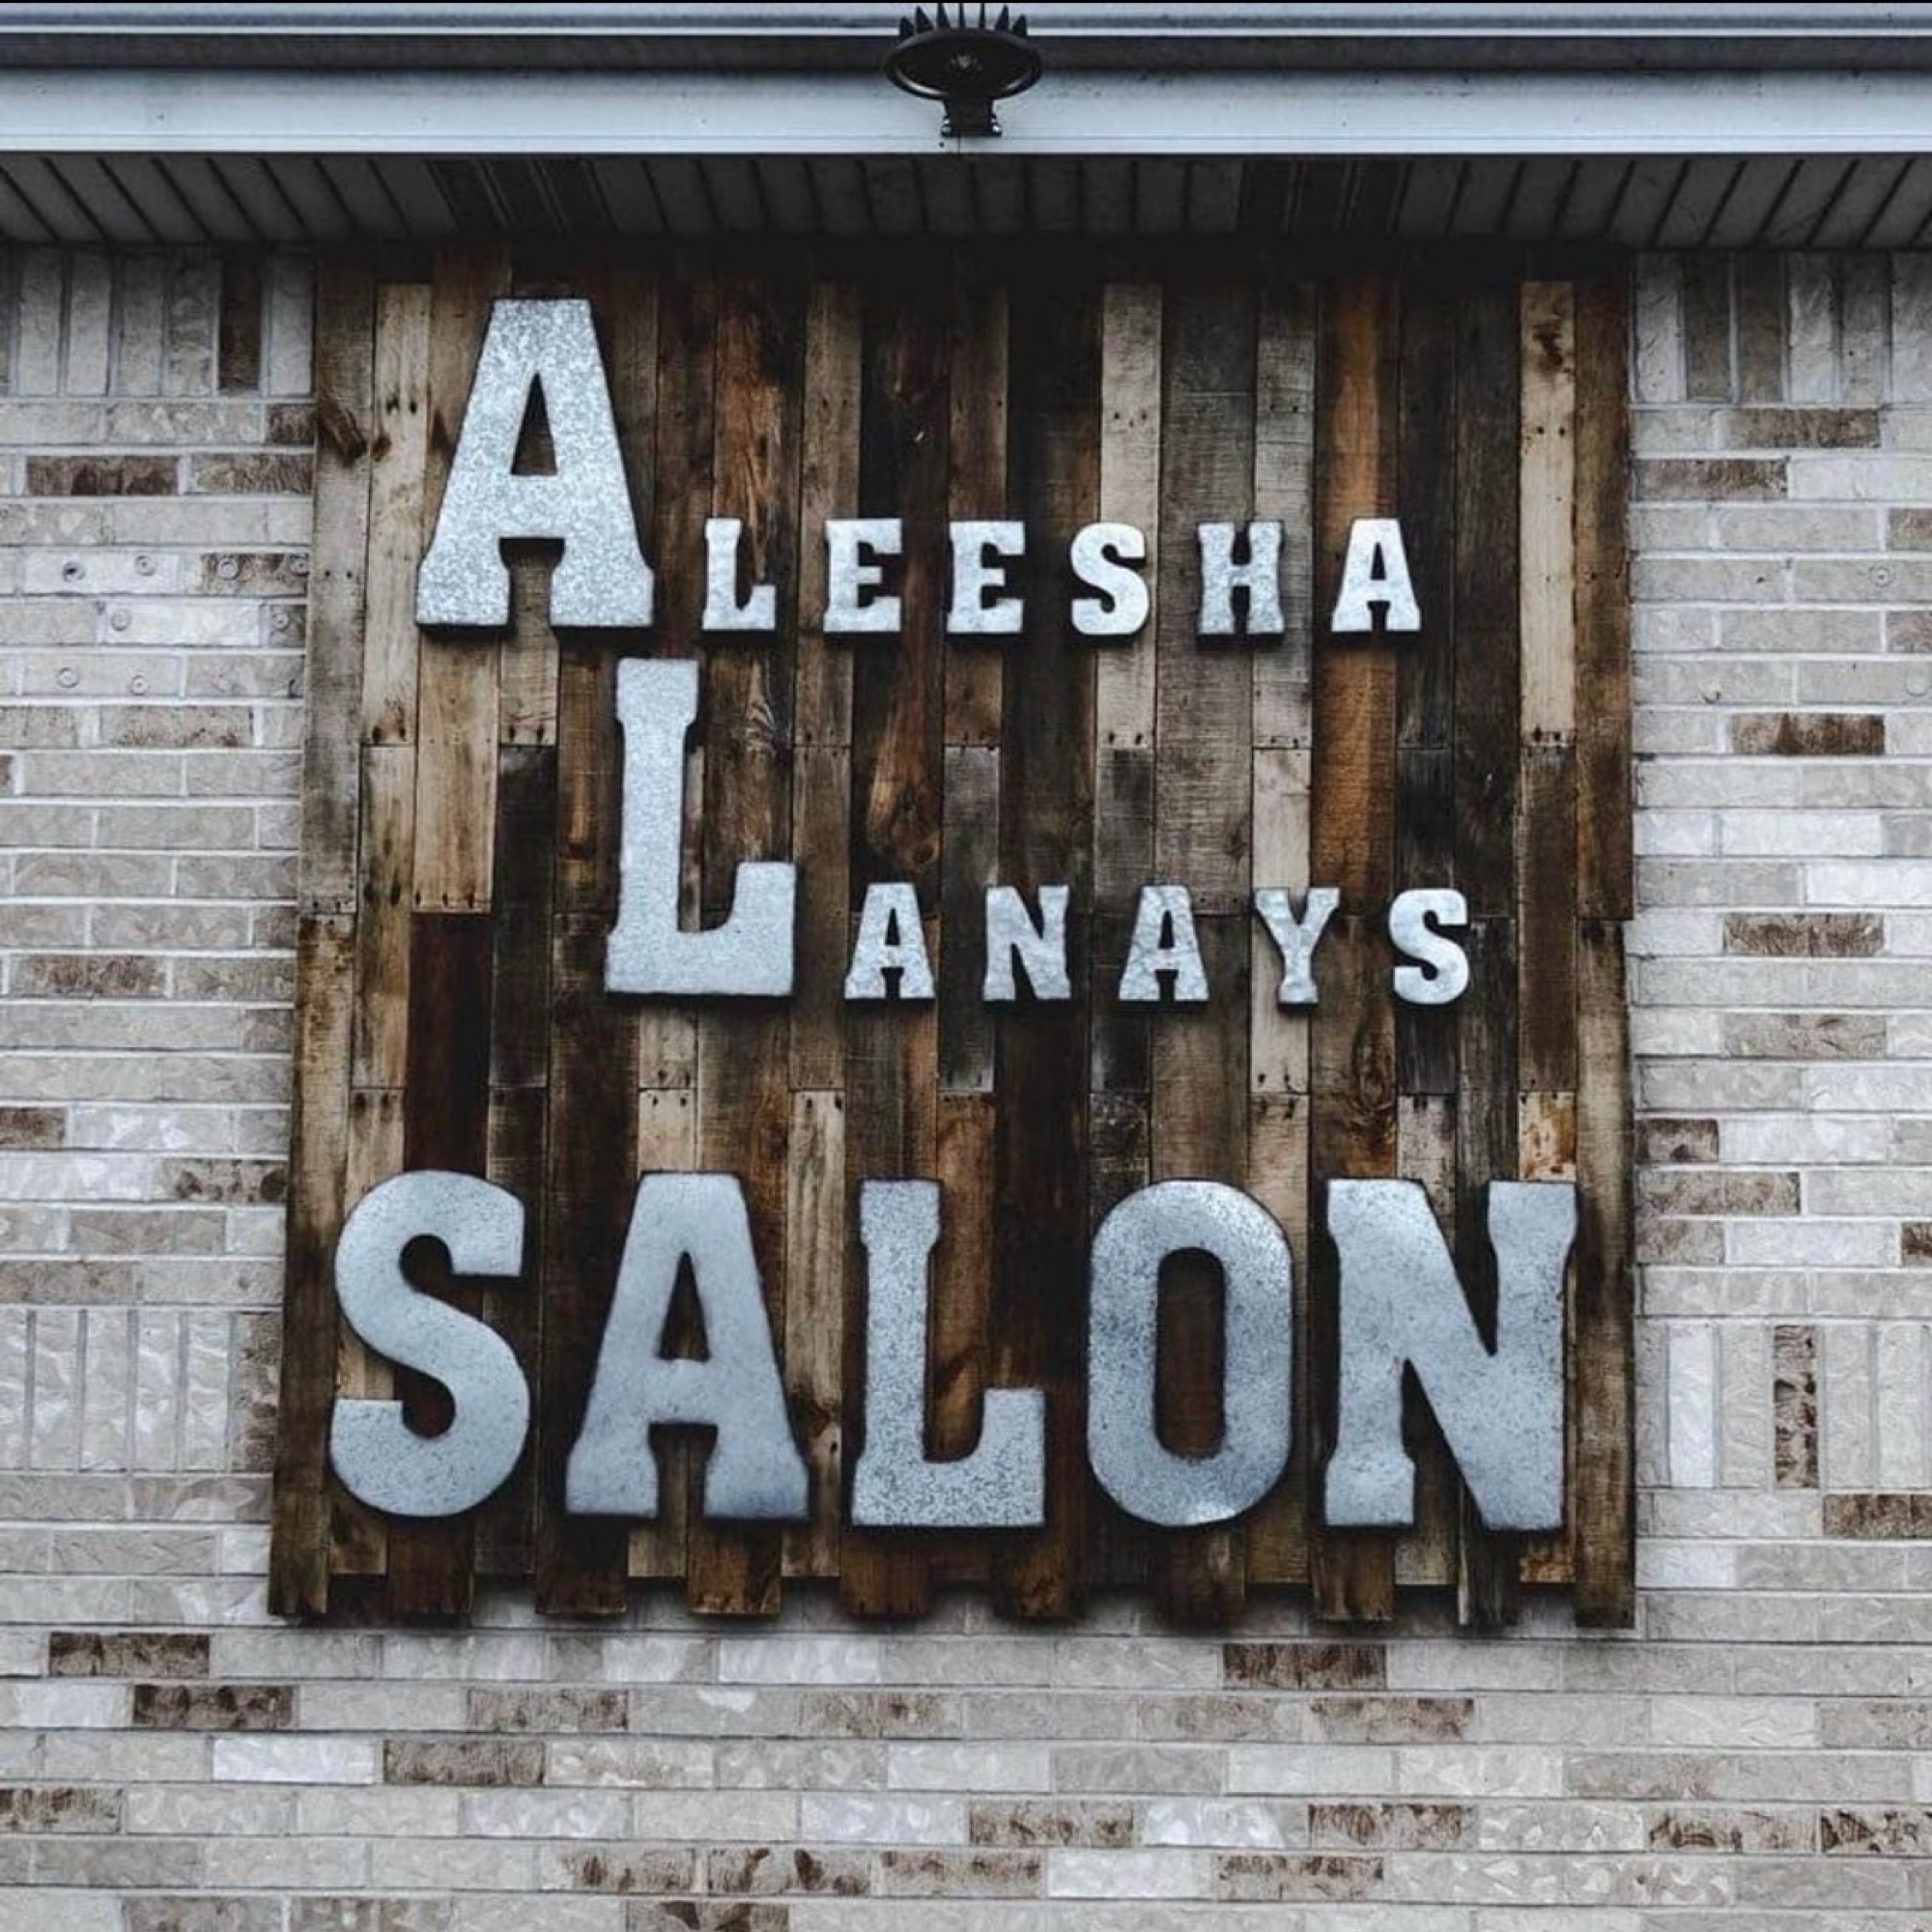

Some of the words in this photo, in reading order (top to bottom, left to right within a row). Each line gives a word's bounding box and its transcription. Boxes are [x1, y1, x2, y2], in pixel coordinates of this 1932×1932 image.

[415, 298, 1422, 637] ALEESHA
[604, 657, 1471, 1006] LANAYS
[329, 1171, 1577, 1529] SALON
